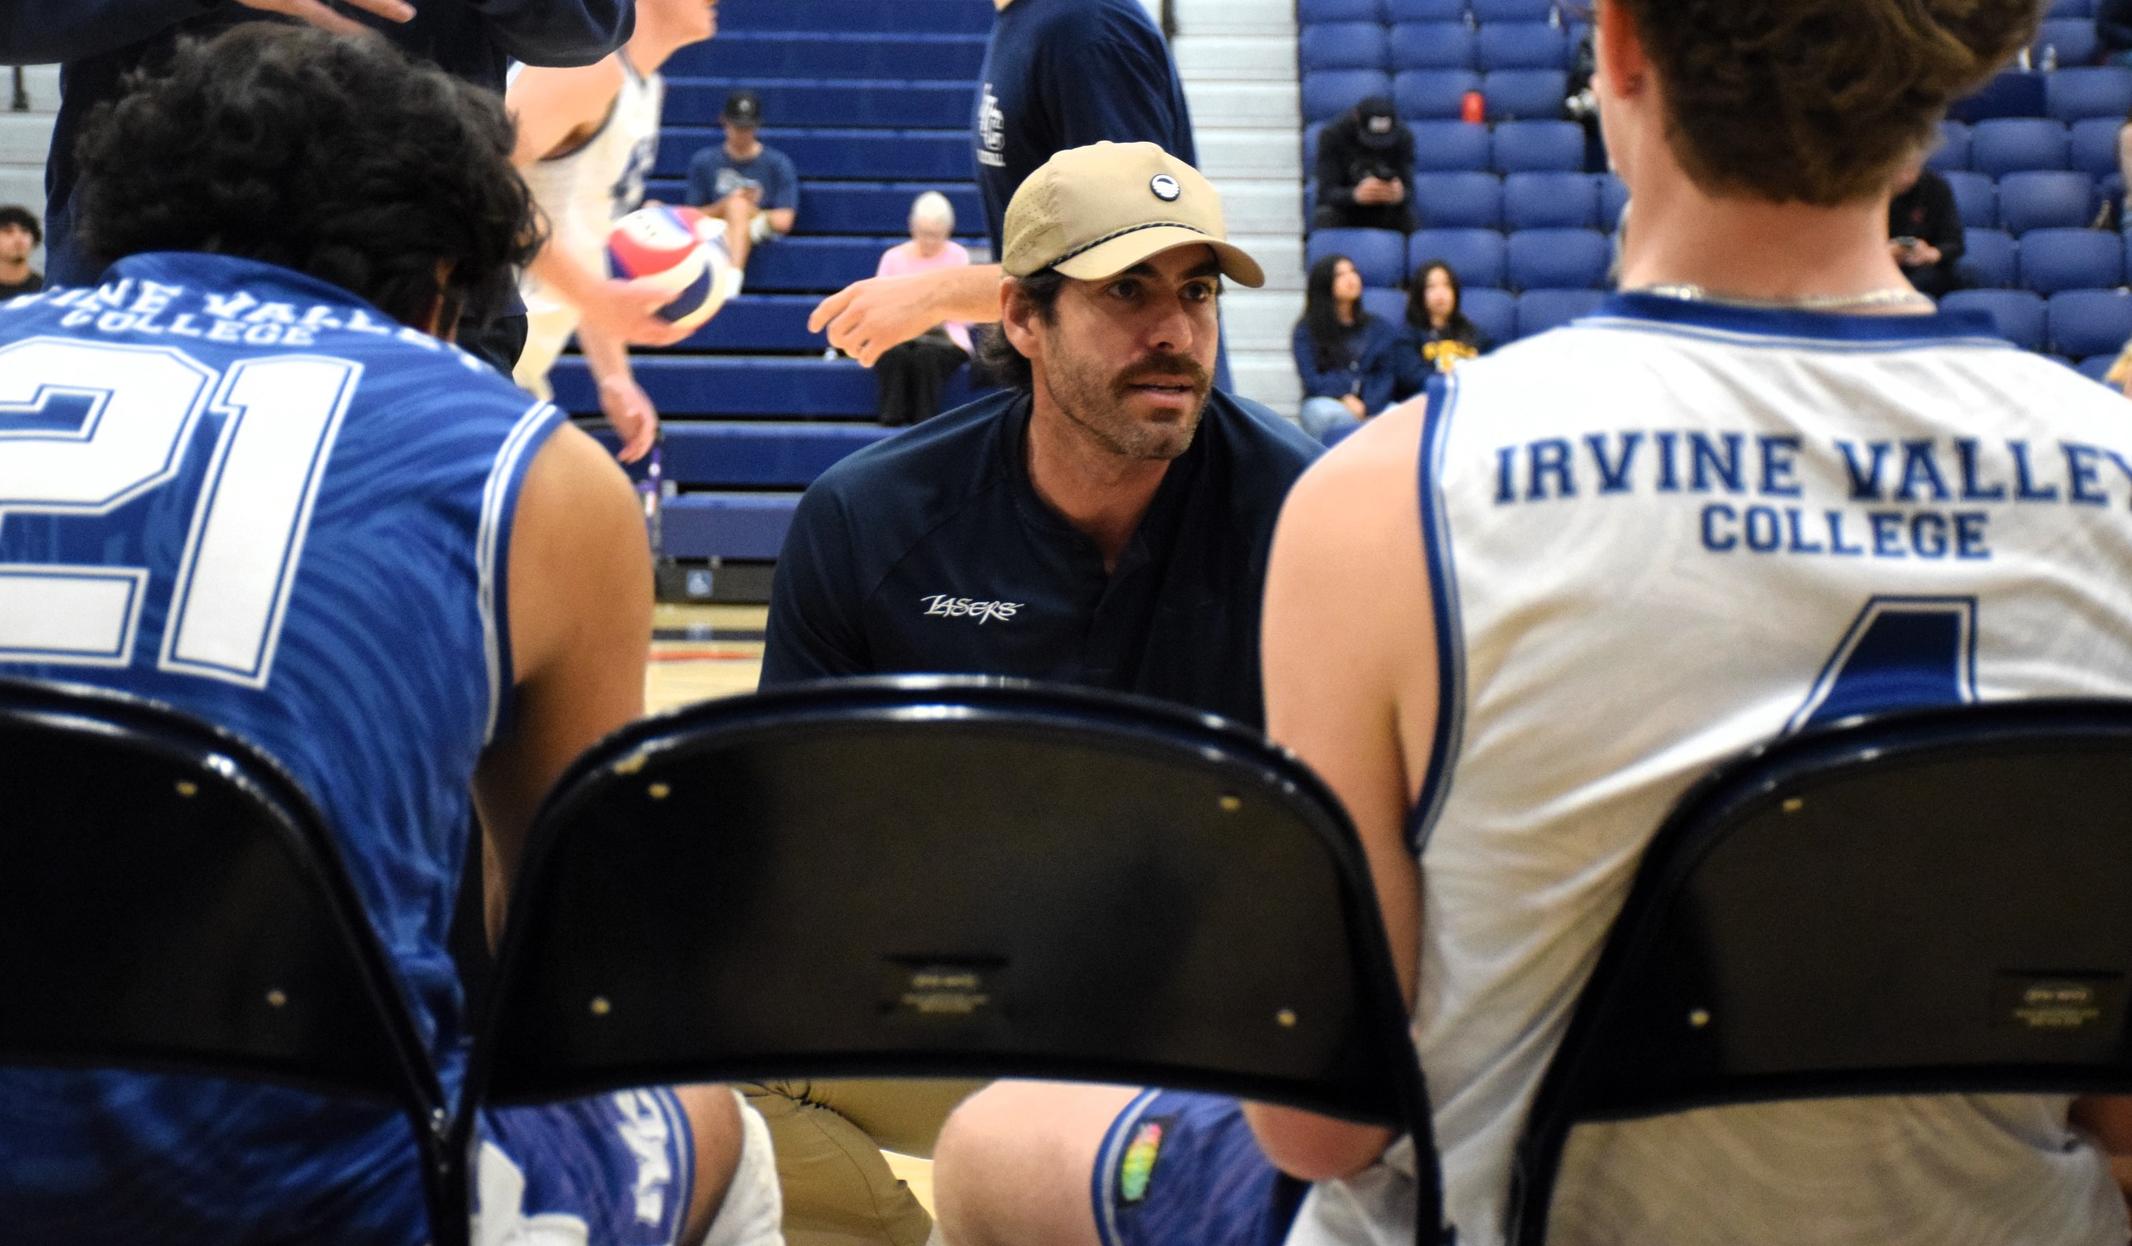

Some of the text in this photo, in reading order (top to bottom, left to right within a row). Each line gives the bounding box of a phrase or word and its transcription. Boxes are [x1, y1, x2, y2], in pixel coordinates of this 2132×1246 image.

[60, 307, 316, 346] COLLEGE
[1494, 429, 1805, 506] IRVINE
[0, 335, 365, 690] 21
[1700, 502, 1992, 561] COLLEGE
[920, 594, 1025, 625] LASERS
